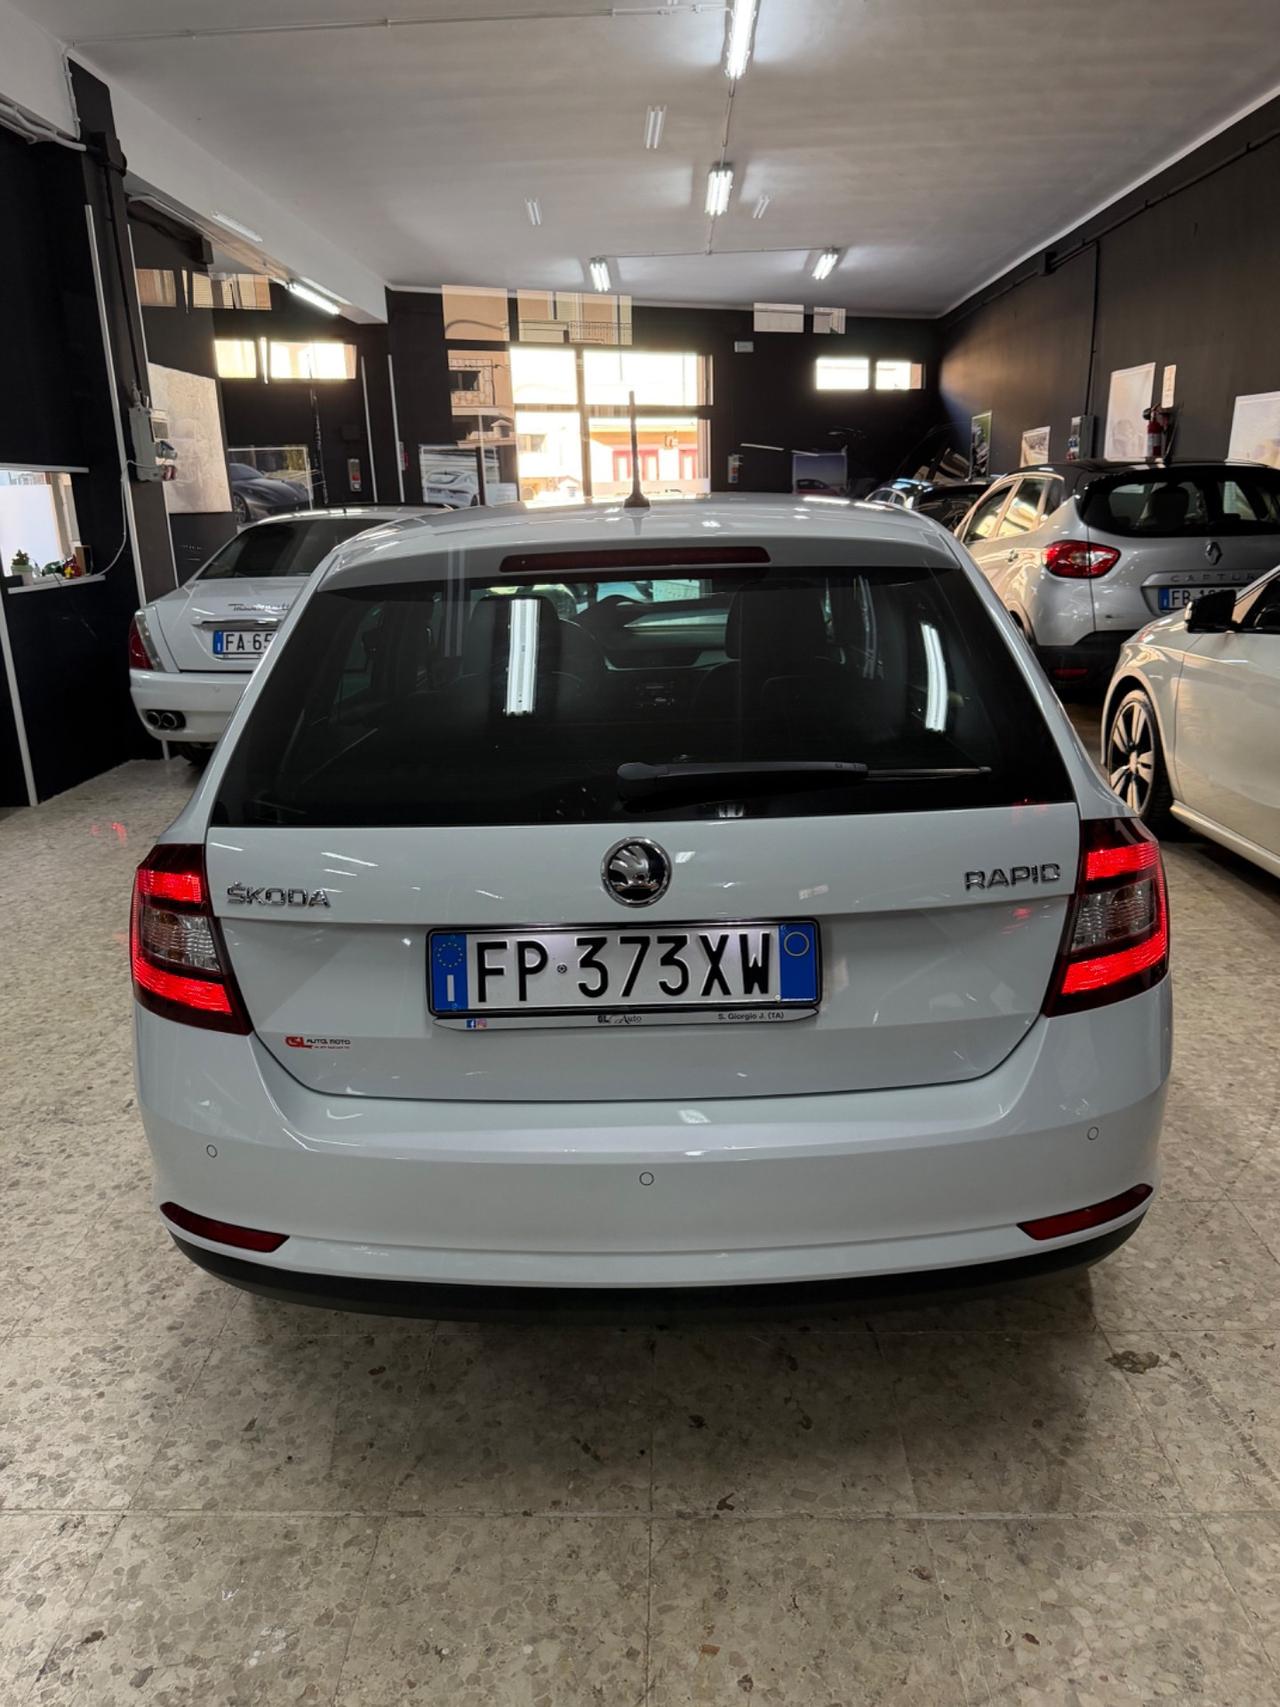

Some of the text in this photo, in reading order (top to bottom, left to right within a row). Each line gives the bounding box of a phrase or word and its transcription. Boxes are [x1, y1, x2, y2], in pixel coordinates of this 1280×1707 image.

[965, 863, 1061, 891] RAPID
[227, 880, 331, 908] ŠKODA
[728, 1012, 758, 1021] Giorgio
[767, 1012, 784, 1020] (TA)
